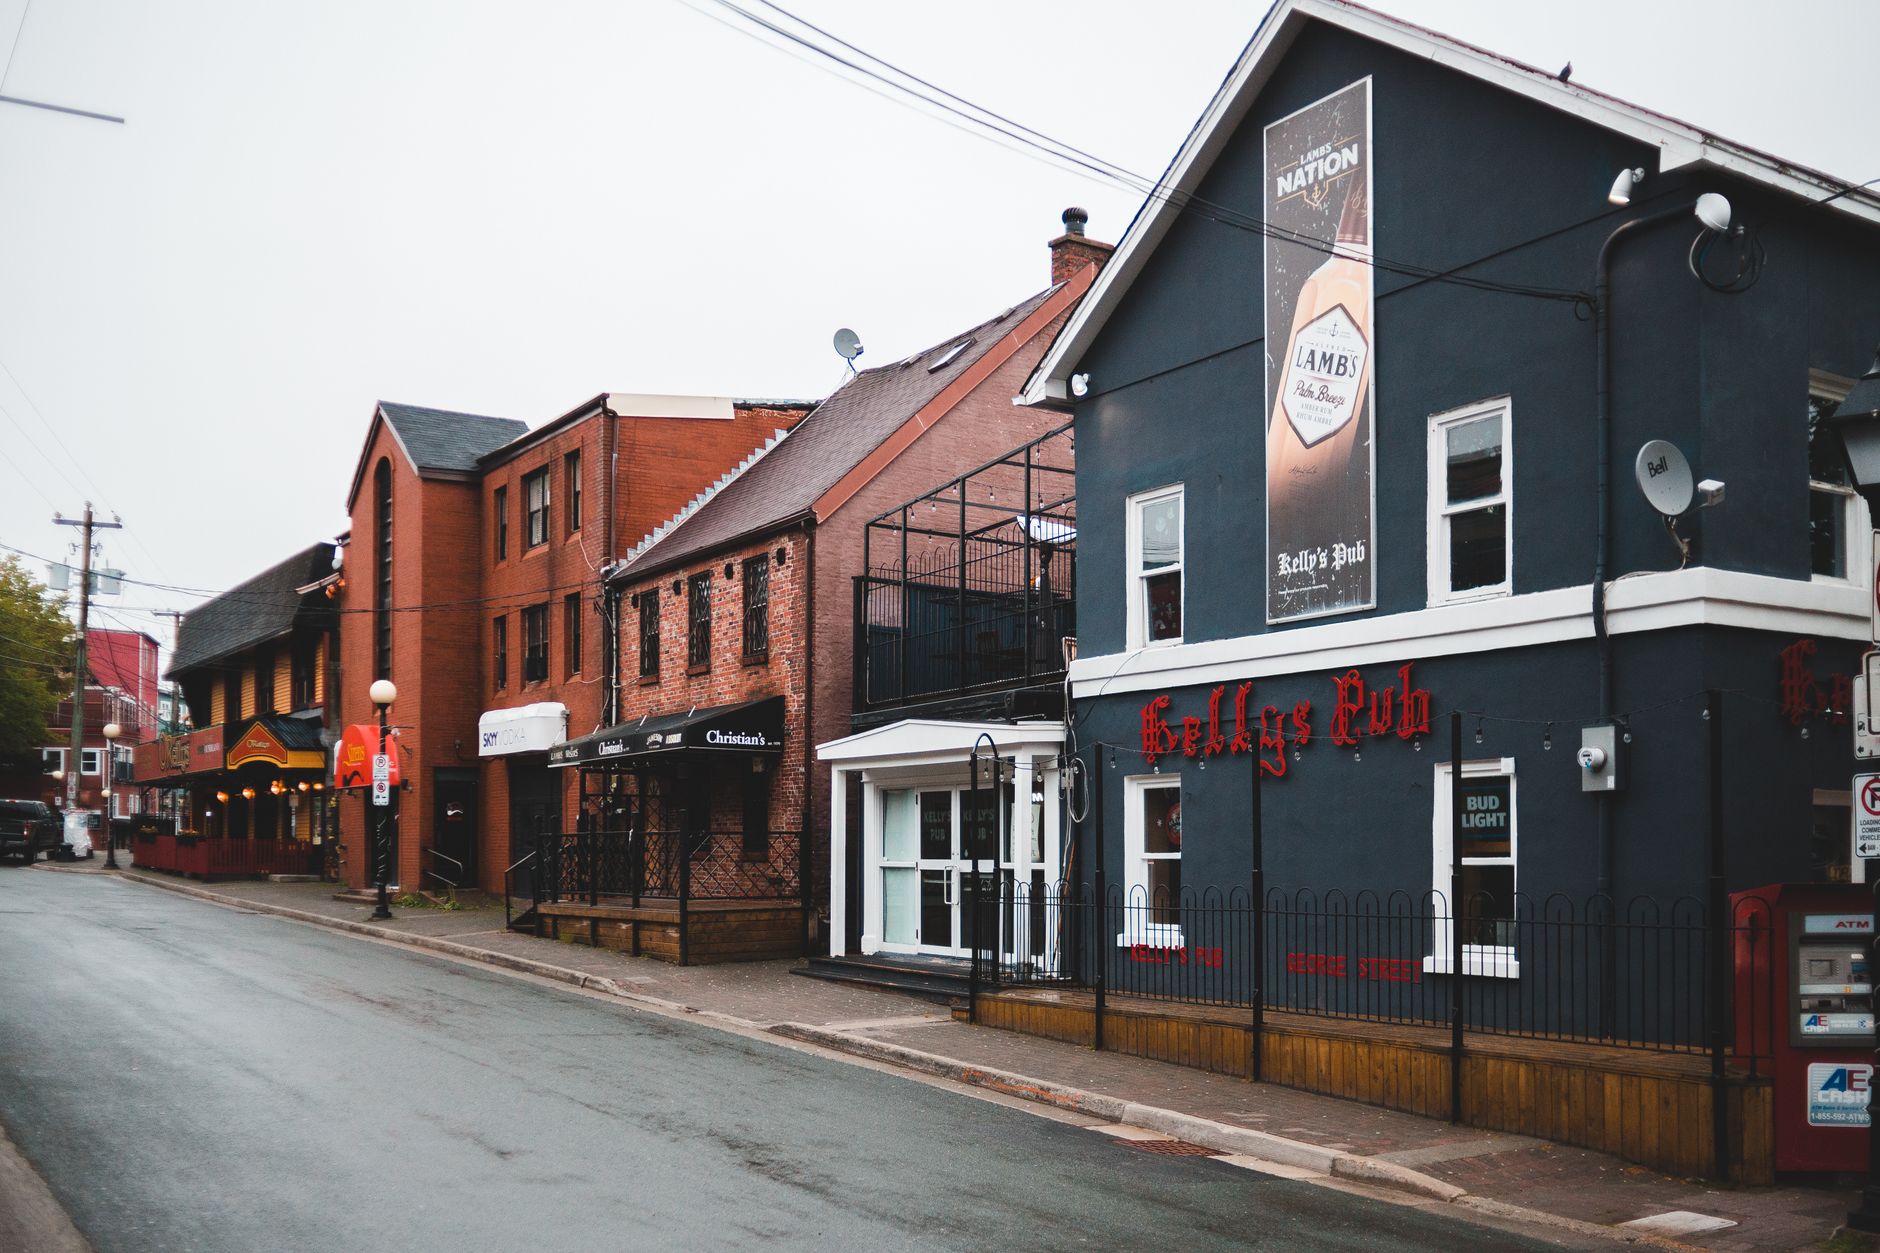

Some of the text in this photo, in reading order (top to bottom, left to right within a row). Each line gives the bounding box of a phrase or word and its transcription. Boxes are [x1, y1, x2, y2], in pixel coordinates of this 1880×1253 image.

[1276, 143, 1359, 197] NATION
[1296, 345, 1358, 378] LAMB'S
[1293, 379, 1346, 409] Palm Breeze
[1301, 402, 1333, 415] AMBER RUM
[1647, 455, 1668, 478] Bell
[1277, 540, 1366, 579] Kelly's Pub
[1330, 662, 1431, 746] Pub
[483, 730, 498, 748] SKYY
[706, 729, 766, 746] Christian's
[598, 739, 624, 756] Christian's
[1466, 795, 1500, 811] BUD
[963, 808, 994, 824] KELY'S
[1461, 812, 1507, 828] LIGHT
[930, 828, 946, 840] PUB
[1835, 920, 1870, 929] ATM
[1130, 943, 1223, 969] KELLY'S PUB
[1287, 952, 1423, 984] GEORGE STREET
[1805, 1014, 1828, 1026] AE
[1820, 1068, 1868, 1092] AE
[1817, 1088, 1869, 1104] CASH
